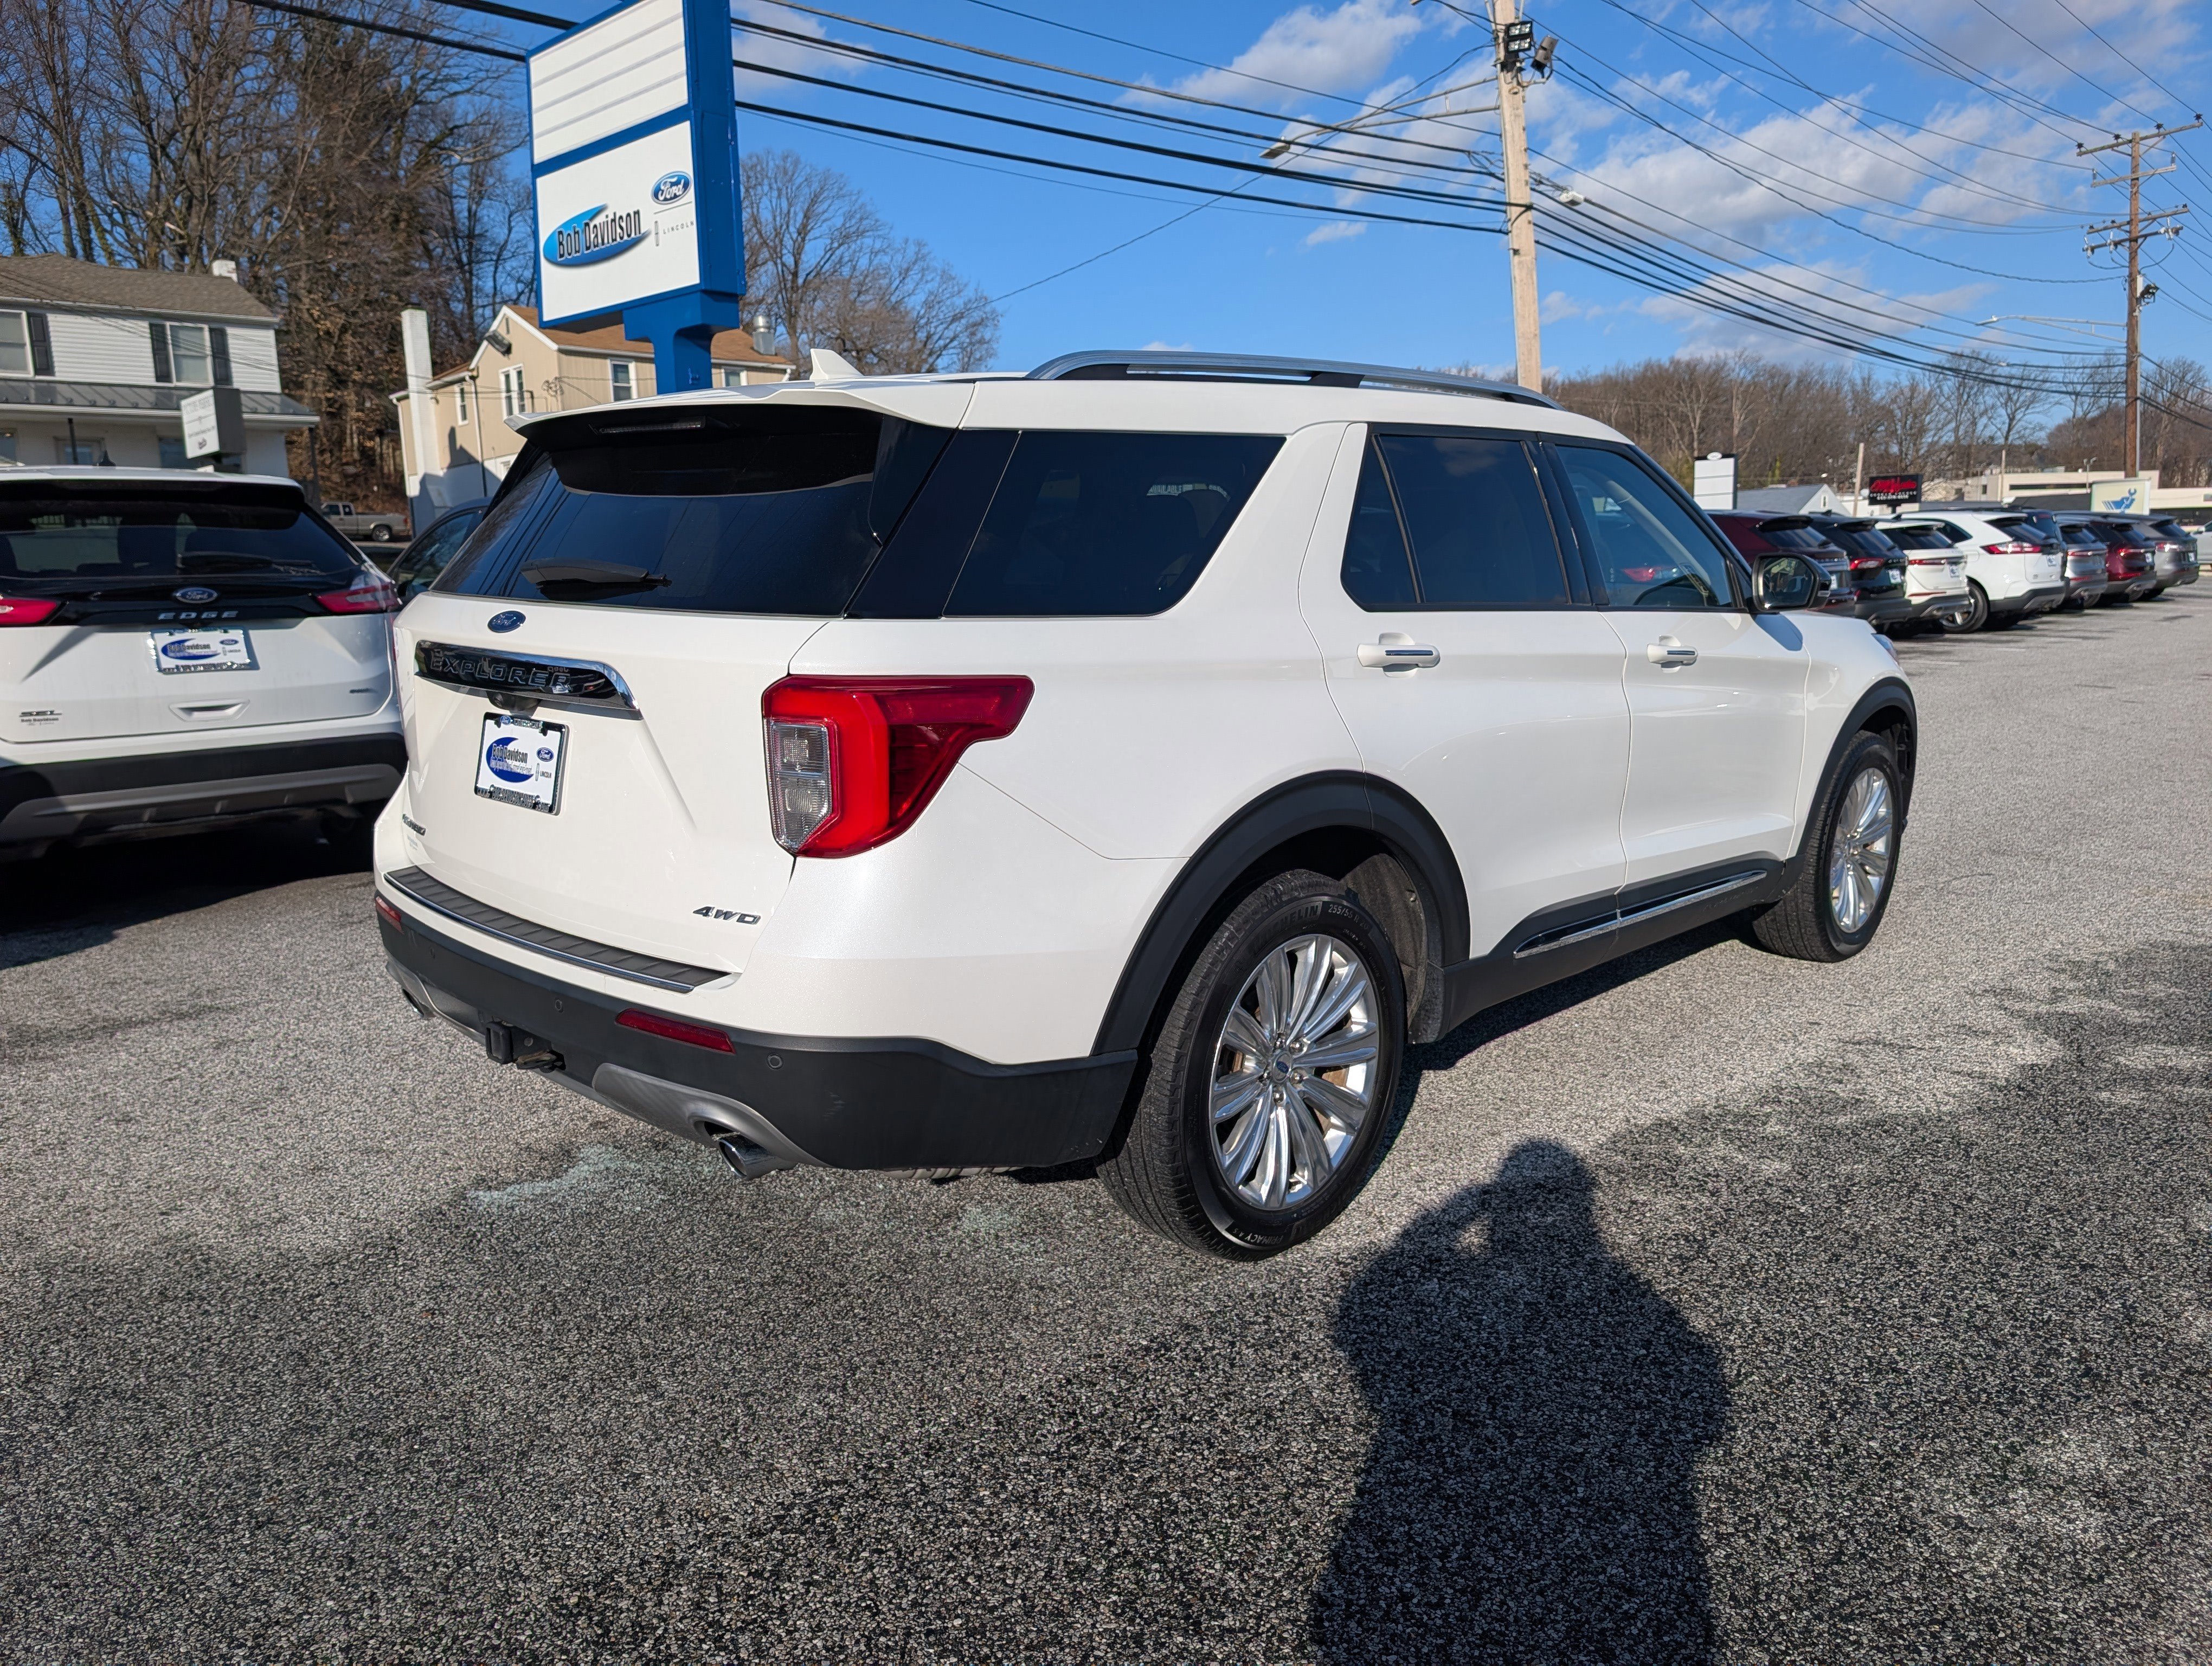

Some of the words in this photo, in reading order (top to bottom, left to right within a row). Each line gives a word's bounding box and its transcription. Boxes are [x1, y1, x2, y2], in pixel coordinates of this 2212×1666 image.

[658, 177, 684, 201] Ford
[557, 225, 581, 260] Bob
[583, 209, 642, 253] Davidson
[663, 221, 694, 234] LINCOLN
[158, 611, 239, 620] EDGE
[492, 614, 516, 626] Ford
[430, 649, 571, 690] EXPLORER
[493, 744, 504, 758] Bob
[504, 746, 528, 764] Davidson
[539, 748, 551, 760] Ford
[692, 906, 761, 925] 4WD
[1328, 904, 1353, 919] 255/55
[1244, 1232, 1284, 1245] PRIMACY
